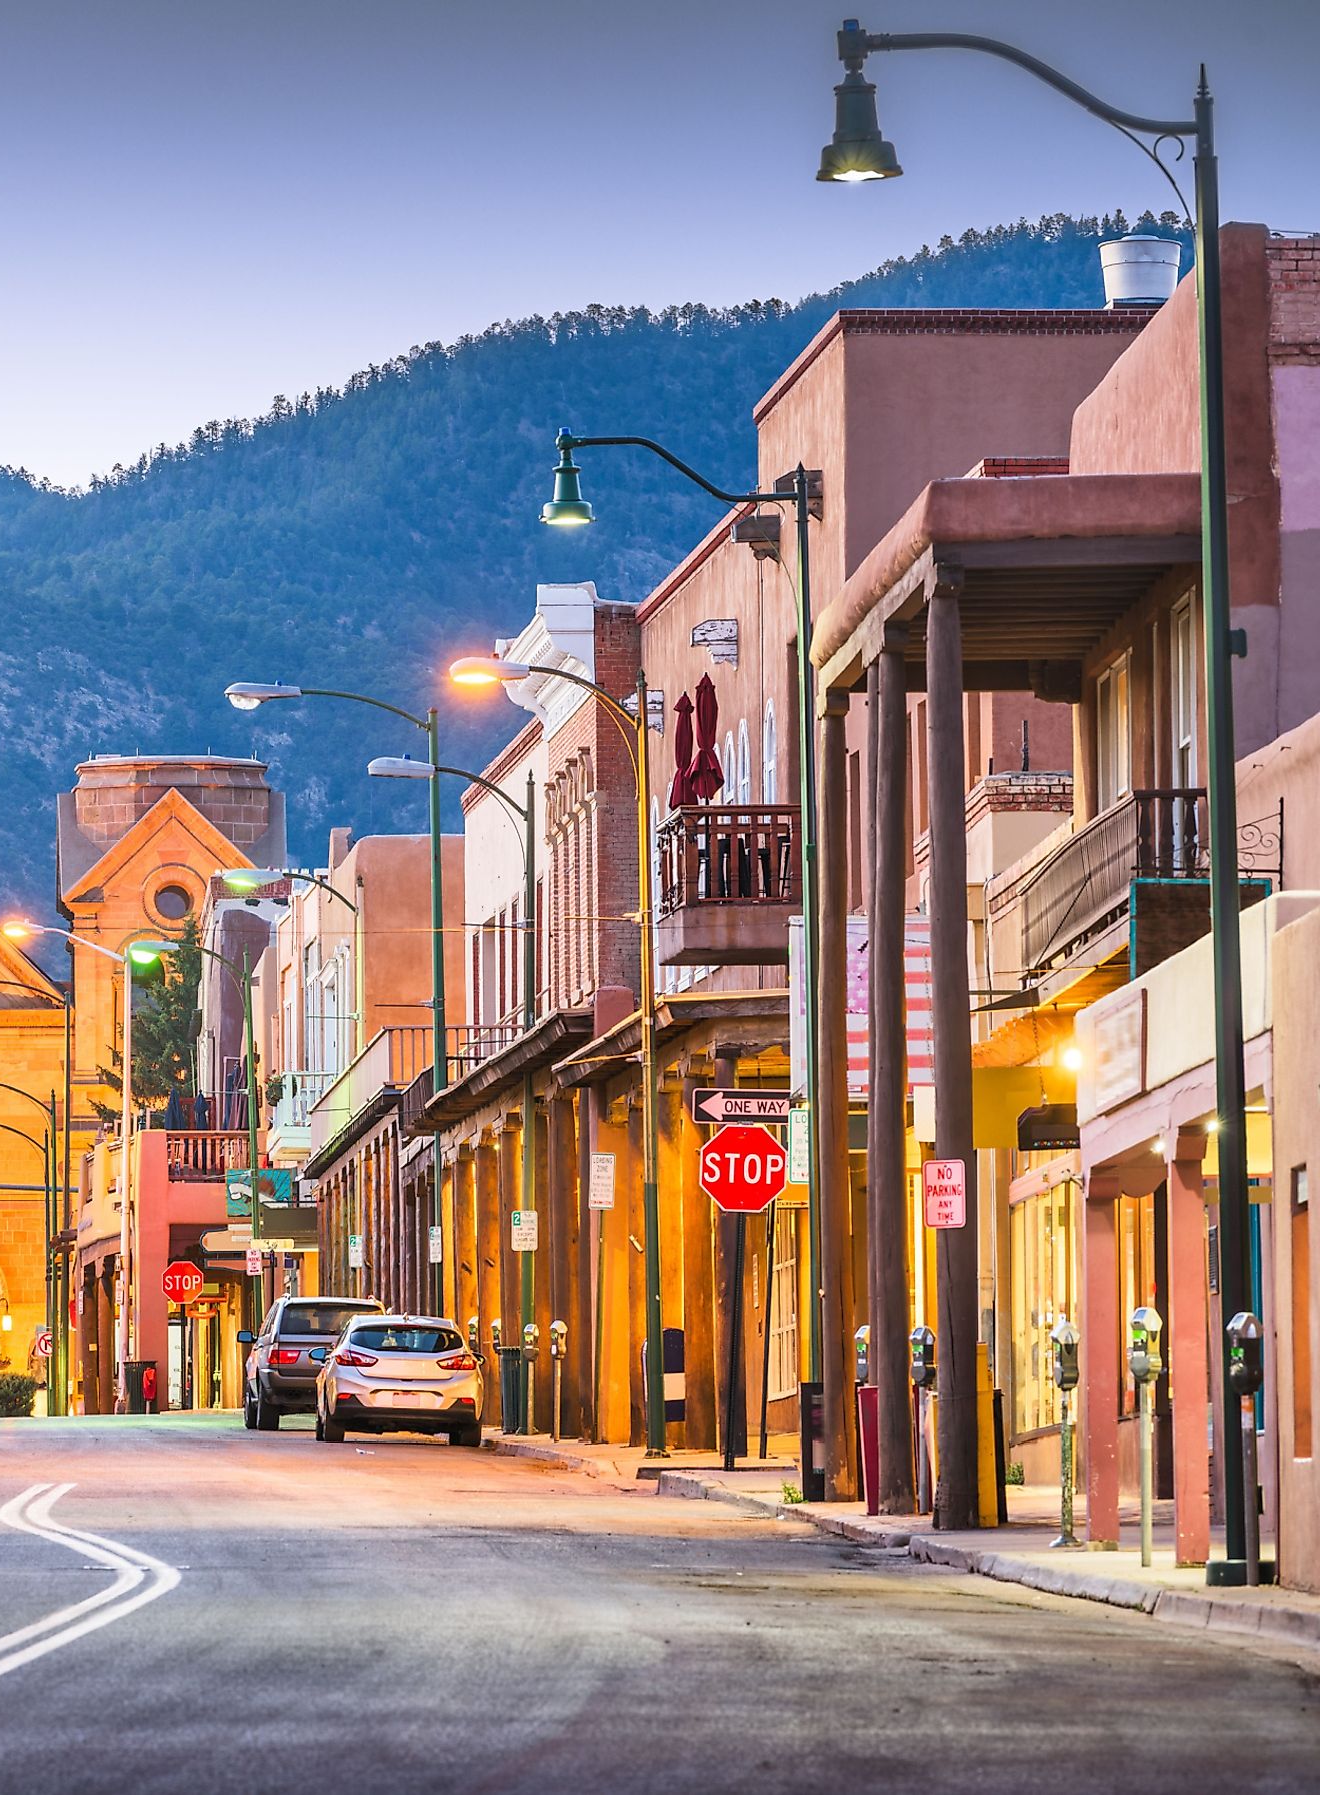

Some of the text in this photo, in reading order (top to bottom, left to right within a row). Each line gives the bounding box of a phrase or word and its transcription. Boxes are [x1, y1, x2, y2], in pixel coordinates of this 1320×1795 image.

[724, 1100, 786, 1114] ONE WAY
[703, 1151, 785, 1186] STOP
[937, 1167, 953, 1180] NO
[927, 1183, 962, 1197] PARKING
[938, 1200, 953, 1208] ANY
[514, 1213, 520, 1225] 2
[937, 1211, 954, 1221] TIME
[164, 1274, 201, 1291] STOP
